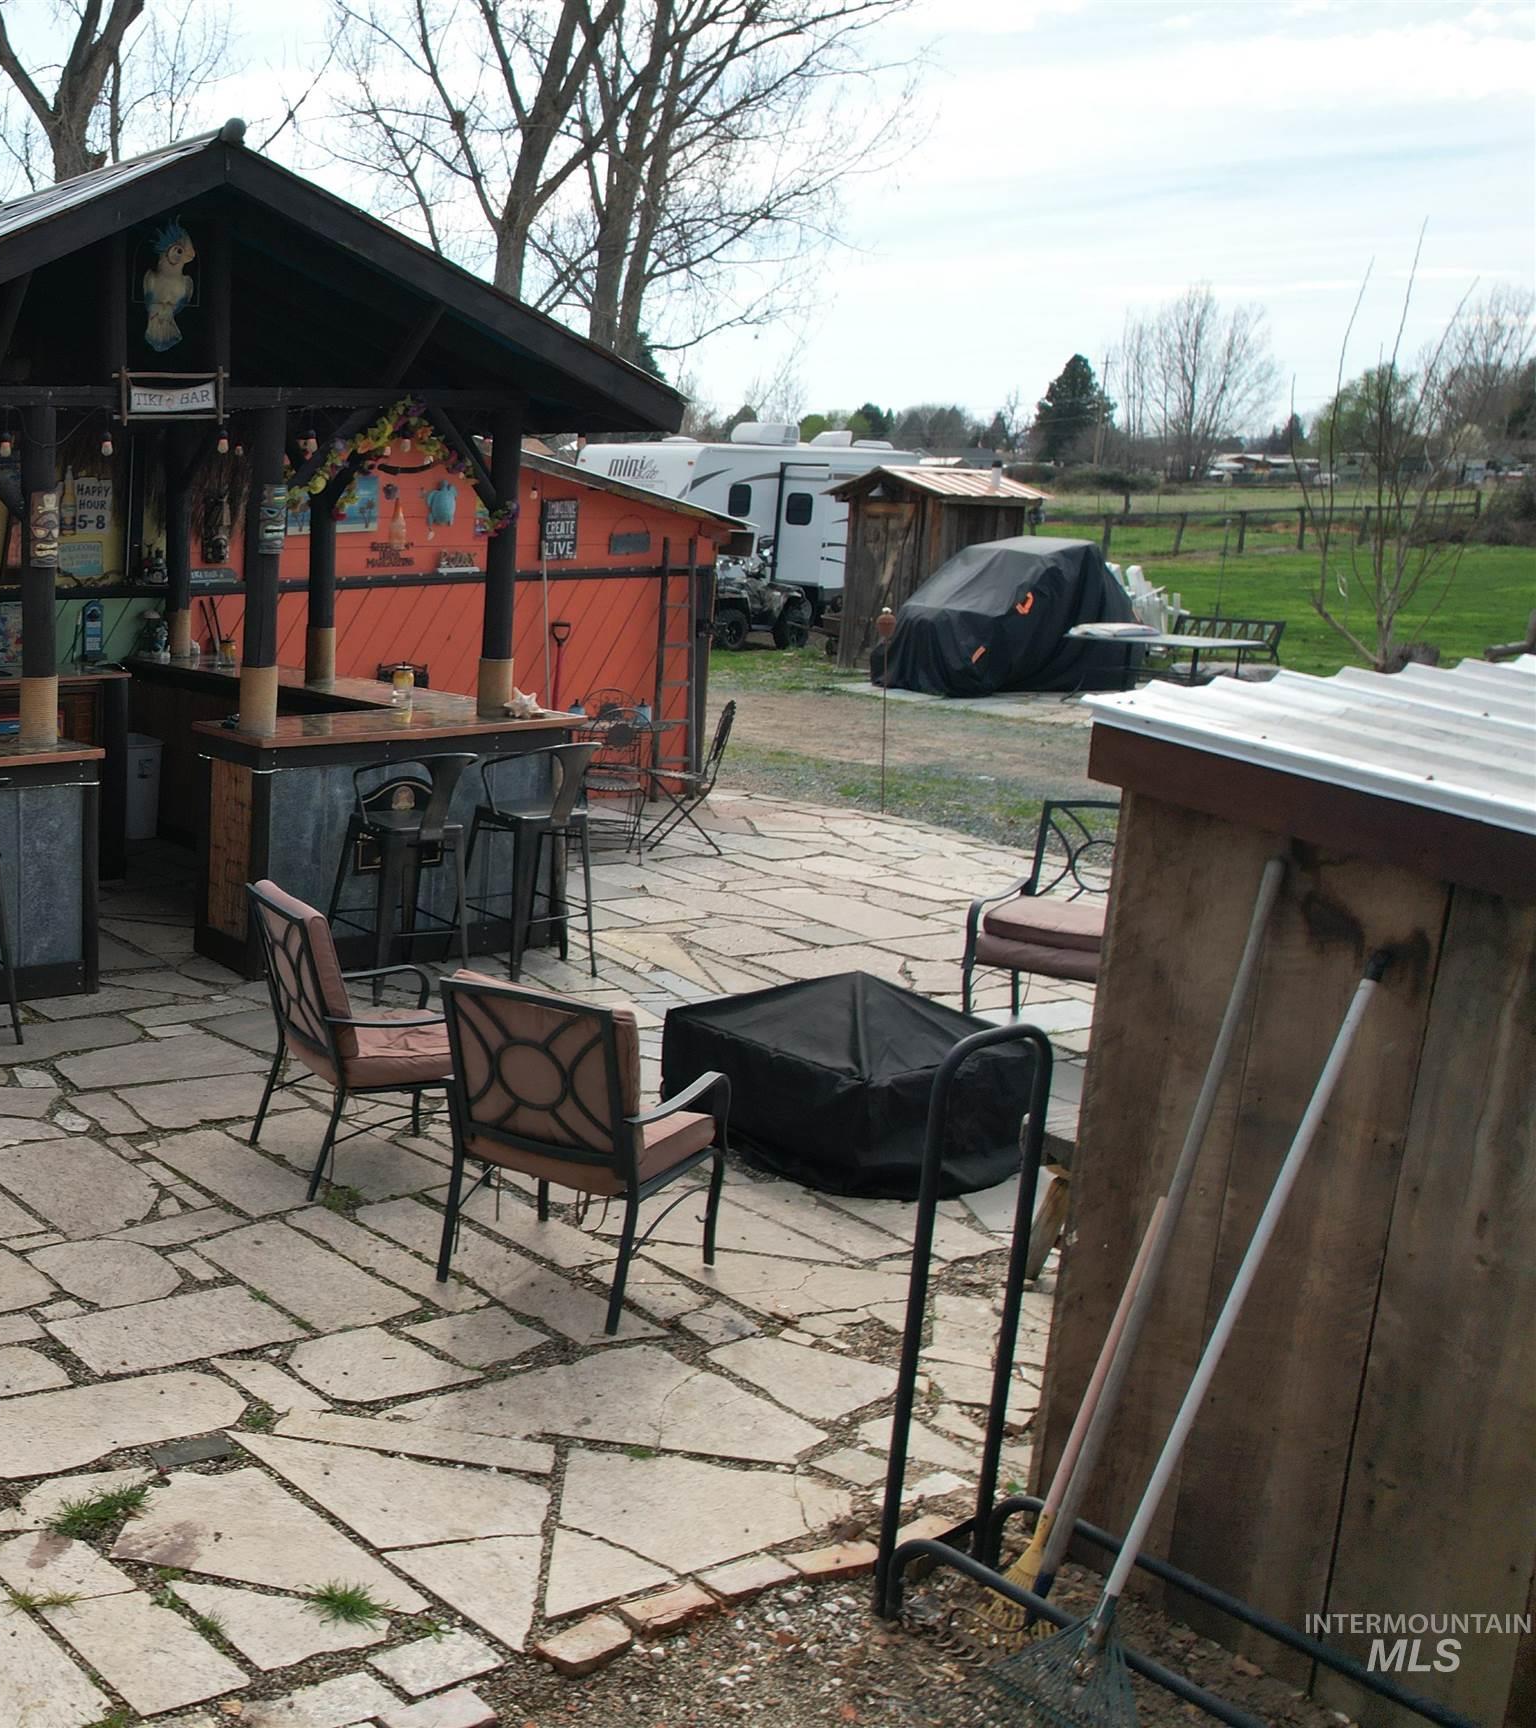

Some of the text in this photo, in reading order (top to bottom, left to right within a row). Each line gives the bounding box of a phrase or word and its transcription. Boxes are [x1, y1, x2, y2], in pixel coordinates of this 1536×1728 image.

[134, 390, 211, 406] TIKI BAR
[607, 456, 646, 477] mini
[77, 484, 112, 497] HAPPY
[79, 500, 106, 510] HOUR
[78, 515, 106, 529] 5-8
[546, 521, 576, 535] CREATE
[545, 541, 575, 556] LIVE
